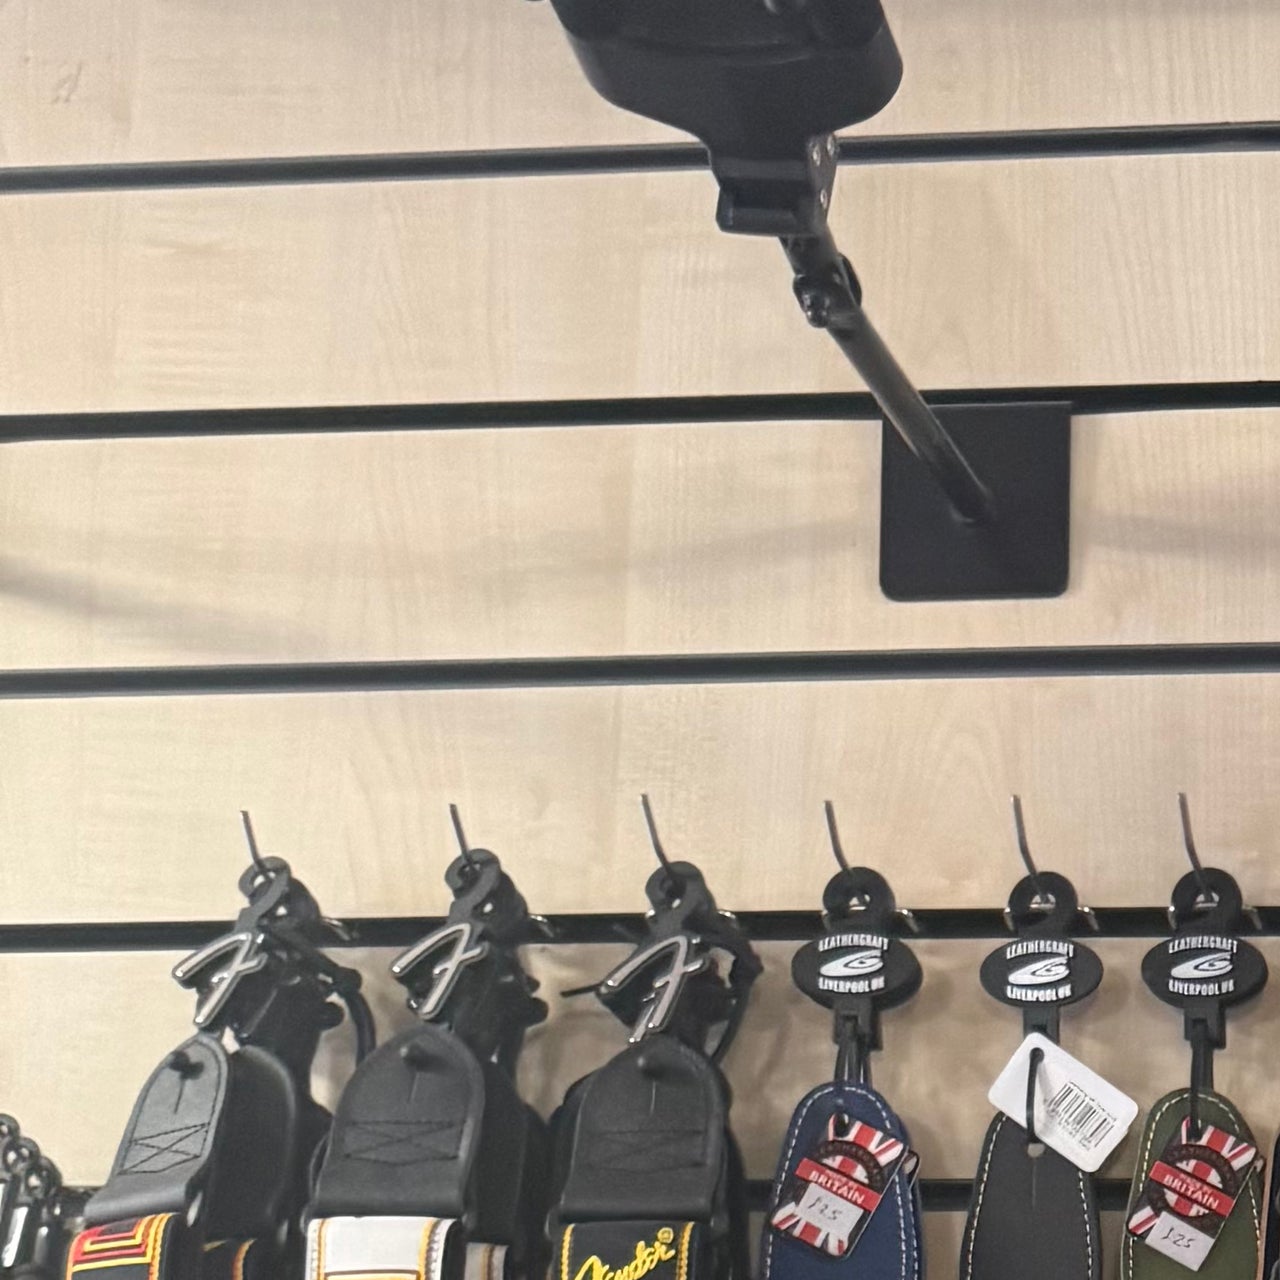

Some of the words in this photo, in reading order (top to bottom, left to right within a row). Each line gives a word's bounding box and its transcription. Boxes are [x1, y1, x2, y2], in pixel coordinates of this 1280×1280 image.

[1168, 979, 1219, 996] LIVERPOOL
[809, 1171, 865, 1205] BRITAIN
[1163, 1173, 1220, 1210] BRITAIN
